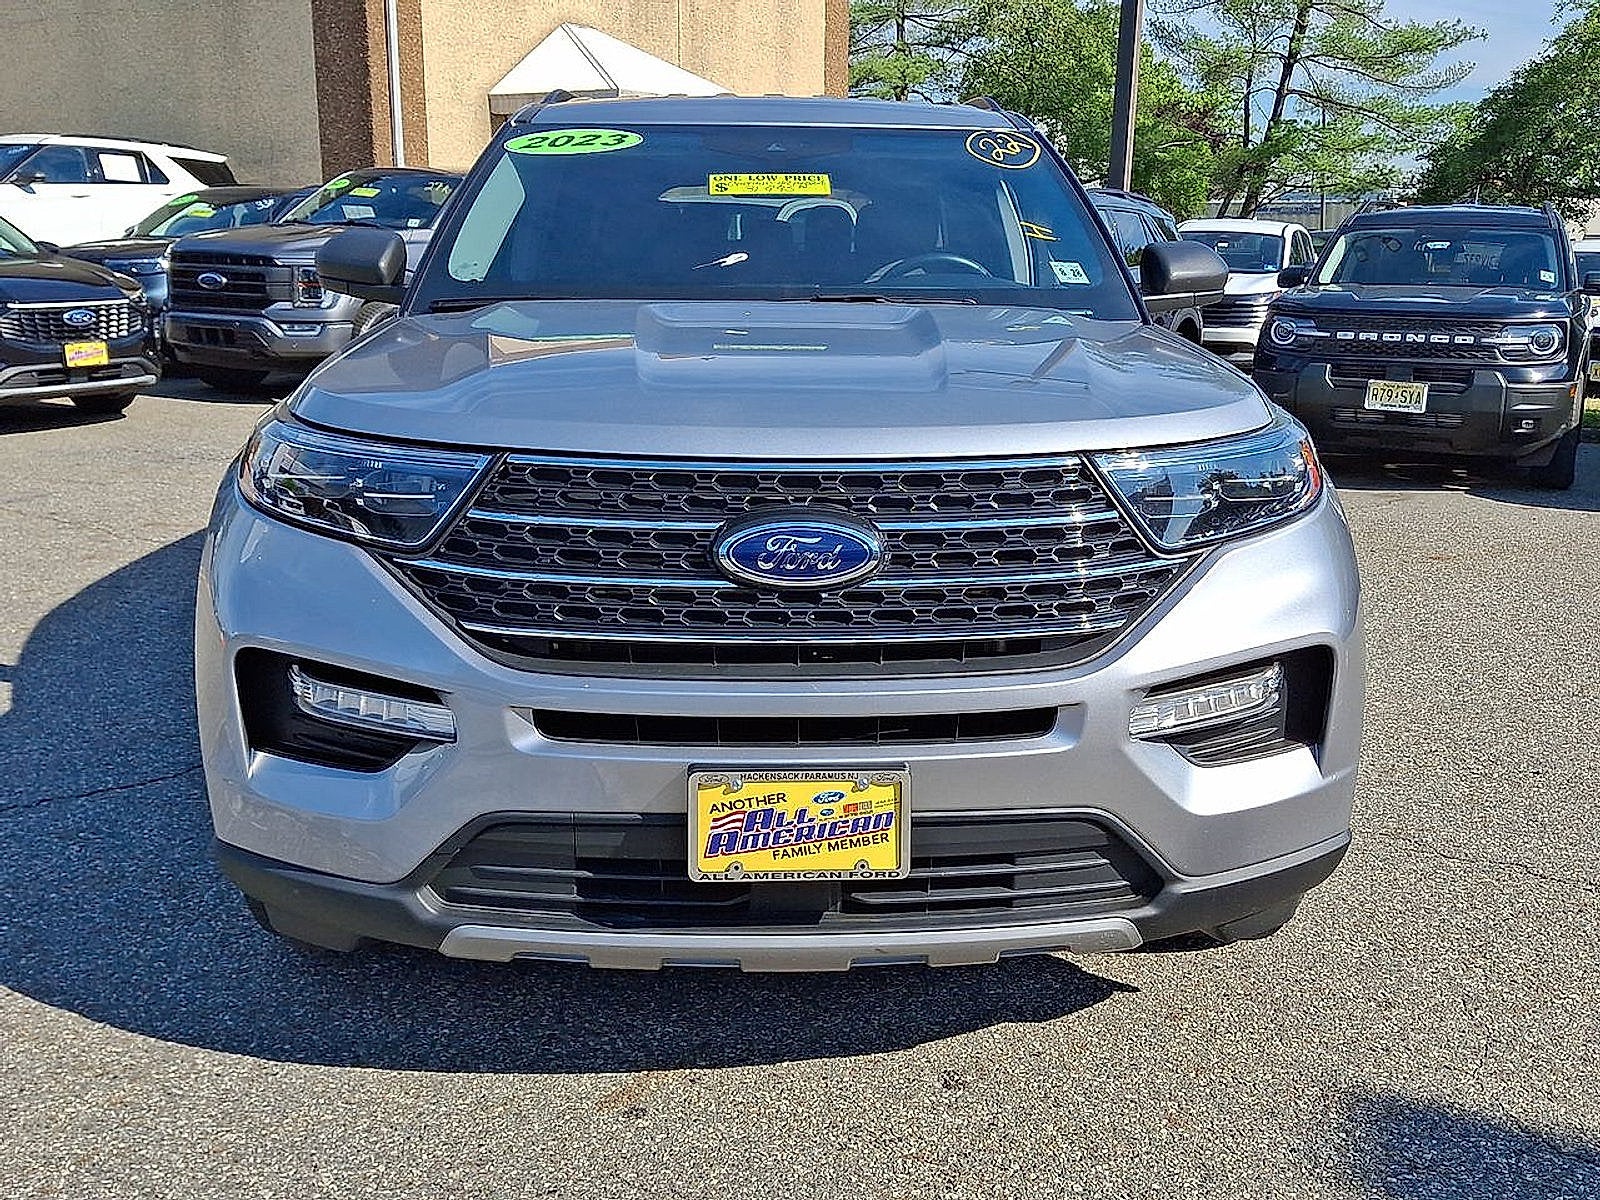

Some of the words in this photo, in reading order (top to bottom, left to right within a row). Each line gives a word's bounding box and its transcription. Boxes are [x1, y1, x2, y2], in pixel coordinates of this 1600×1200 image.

[518, 133, 630, 150] 2023
[1336, 331, 1475, 344] BRONCO
[757, 534, 843, 570] Ford
[709, 792, 787, 814] ANOTHER
[704, 811, 895, 857] AMERICAN
[772, 843, 823, 860] FAMILY
[828, 832, 890, 852] MEMBER
[699, 871, 735, 881] ALL
[740, 871, 843, 880] AMERICAN
[850, 870, 900, 879] FORD
